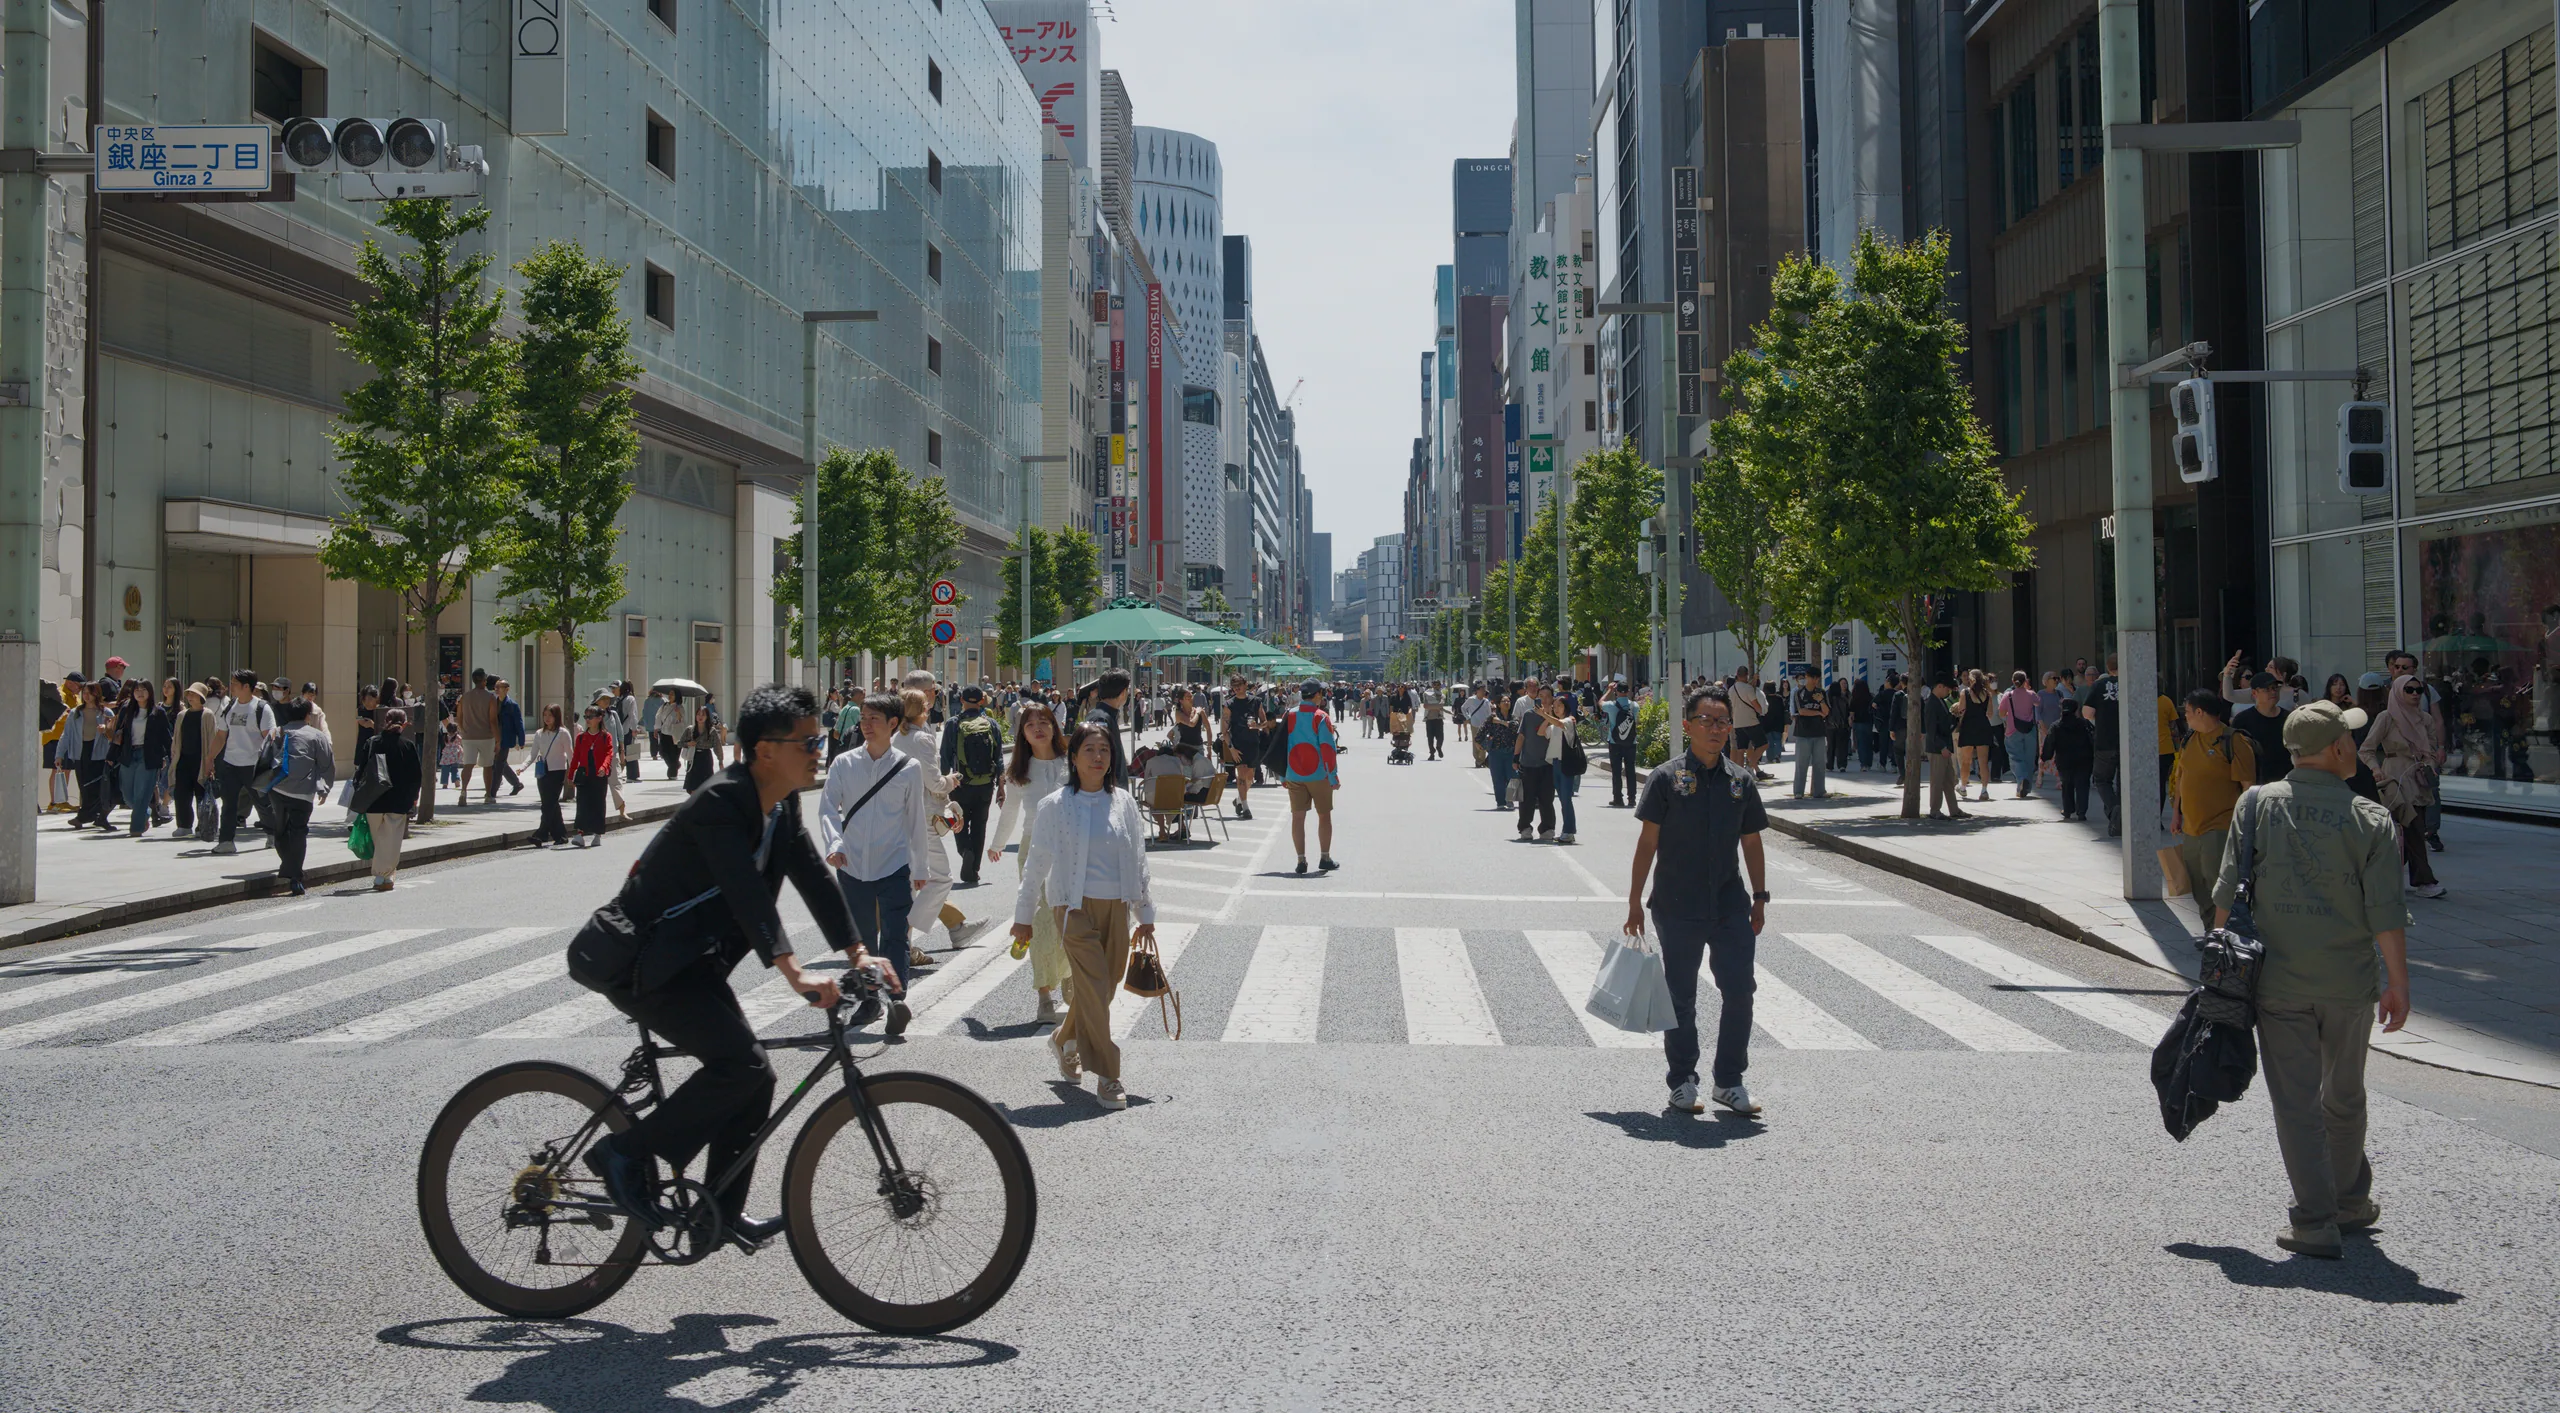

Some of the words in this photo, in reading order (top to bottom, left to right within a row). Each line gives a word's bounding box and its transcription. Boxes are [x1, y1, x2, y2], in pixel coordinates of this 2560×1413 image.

[106, 127, 156, 142] 中央区
[107, 143, 260, 171] 銀座二丁目
[152, 170, 197, 188] Ginza
[202, 172, 213, 187] 2
[1556, 254, 1568, 336] 教文館ビル
[1572, 253, 1583, 336] 教文館ビル
[1529, 254, 1550, 373] 教文館
[1150, 289, 1160, 368] MITSUKOSHI
[1618, 716, 1631, 734] NIKE
[2274, 902, 2302, 914] VIET
[2306, 904, 2332, 915] NAM
